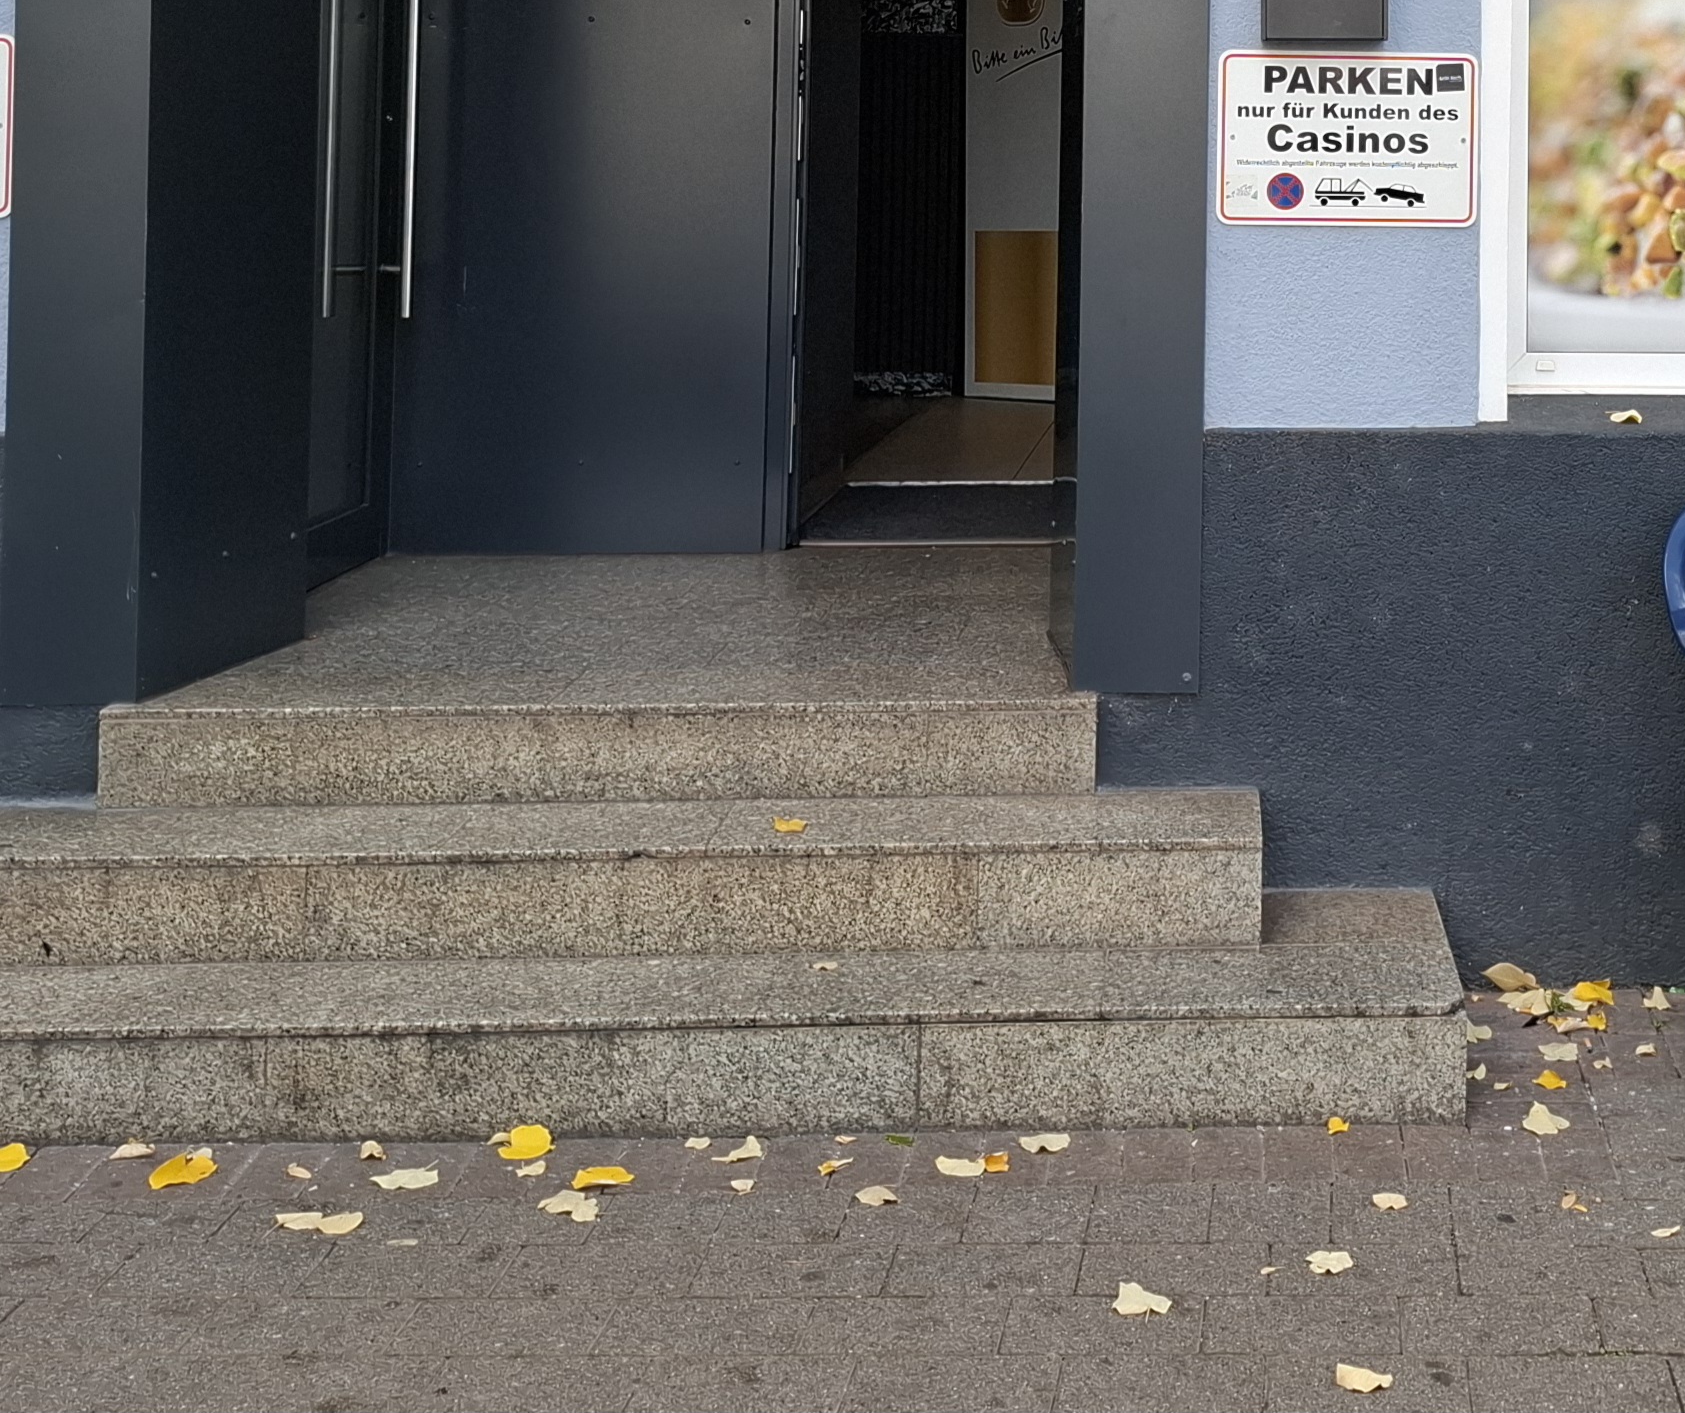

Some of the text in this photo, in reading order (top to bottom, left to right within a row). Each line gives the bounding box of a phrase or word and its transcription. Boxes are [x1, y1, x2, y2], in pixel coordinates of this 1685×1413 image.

[971, 26, 1063, 75] Bitte ein Bi
[1263, 64, 1434, 96] PARKEN
[1237, 101, 1460, 122] nur für Kunden des
[1266, 123, 1430, 155] Casinos
